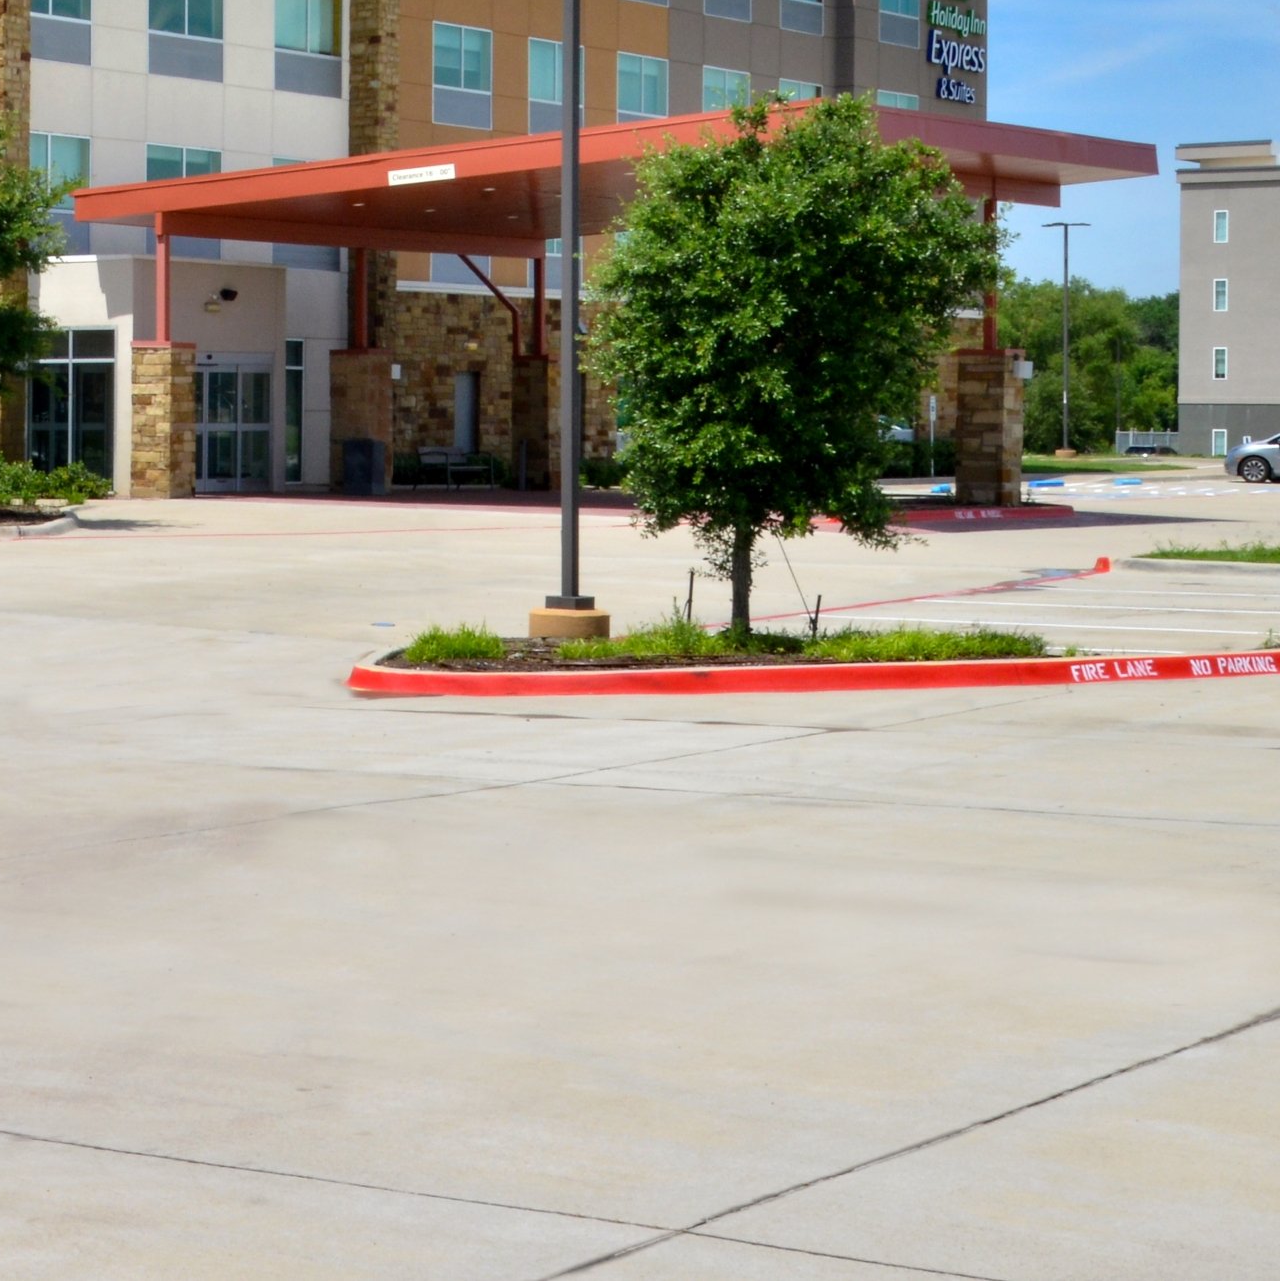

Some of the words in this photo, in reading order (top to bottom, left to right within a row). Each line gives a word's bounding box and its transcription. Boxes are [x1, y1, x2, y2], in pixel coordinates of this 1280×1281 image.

[931, 0, 970, 37] Holiday
[970, 9, 986, 36] Inn
[931, 30, 986, 74] Express
[940, 77, 949, 99] &
[949, 79, 975, 104] Suites
[1070, 662, 1109, 682] FIRE
[1114, 659, 1158, 678] LANE
[1190, 658, 1212, 676] NO
[1217, 655, 1277, 674] PARKING
